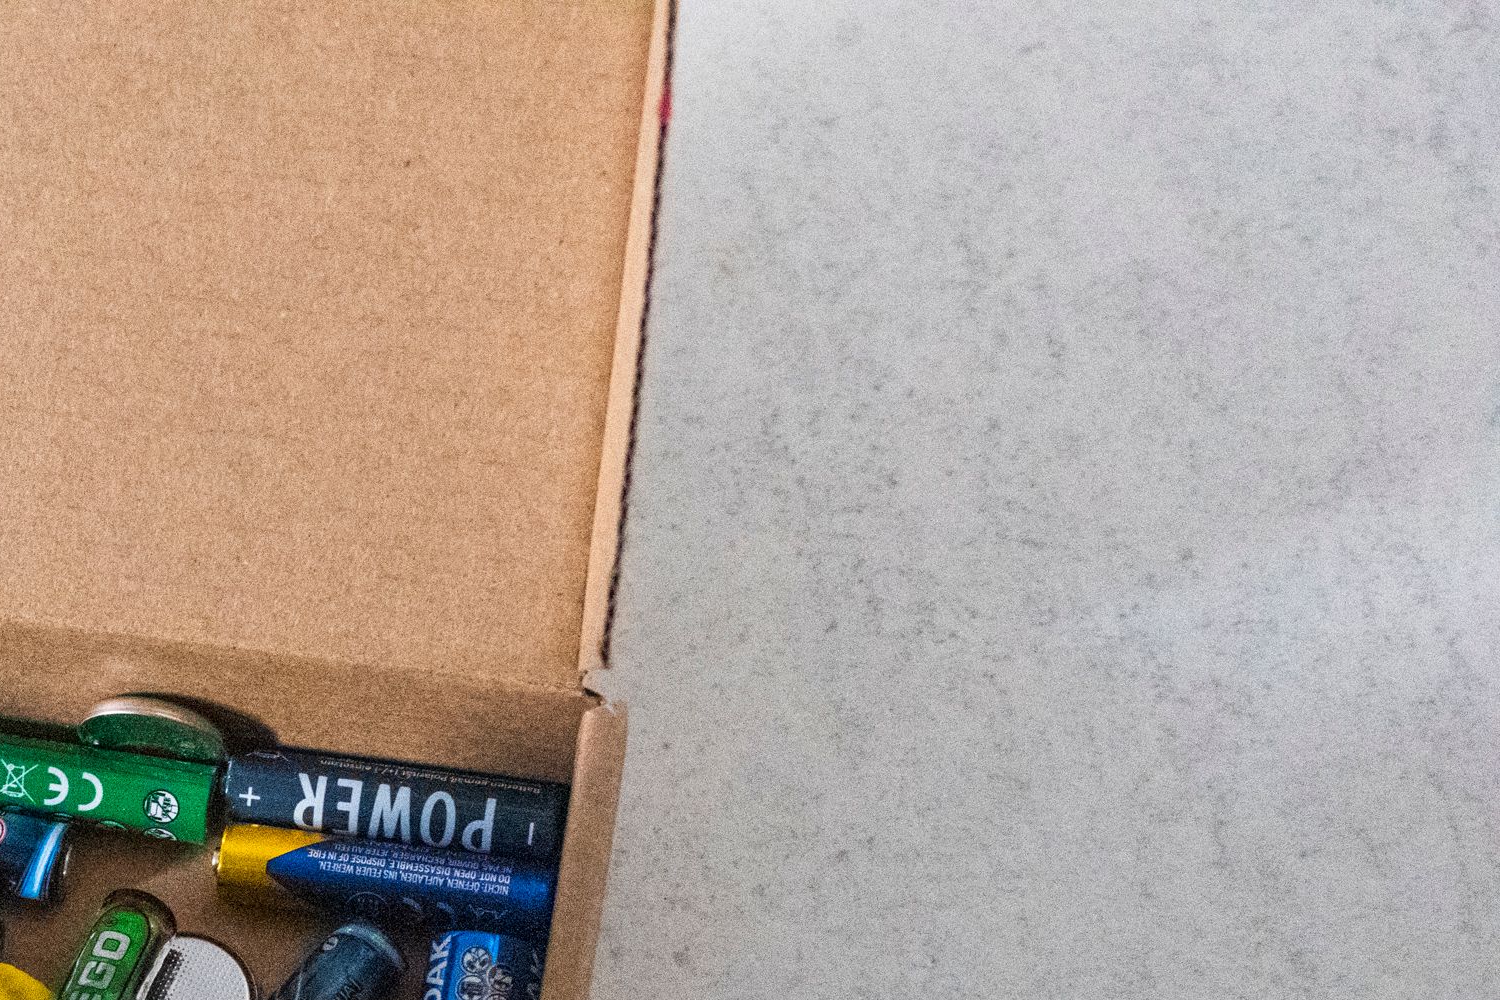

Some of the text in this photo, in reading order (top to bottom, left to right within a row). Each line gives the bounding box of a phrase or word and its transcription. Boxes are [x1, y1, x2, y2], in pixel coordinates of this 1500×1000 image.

[291, 771, 497, 853] POWER
[326, 851, 337, 861] IN
[338, 852, 349, 862] OF
[350, 854, 386, 868] DISPOSE
[355, 865, 383, 879] FEUER
[382, 869, 397, 881] INS
[498, 874, 511, 884] DO
